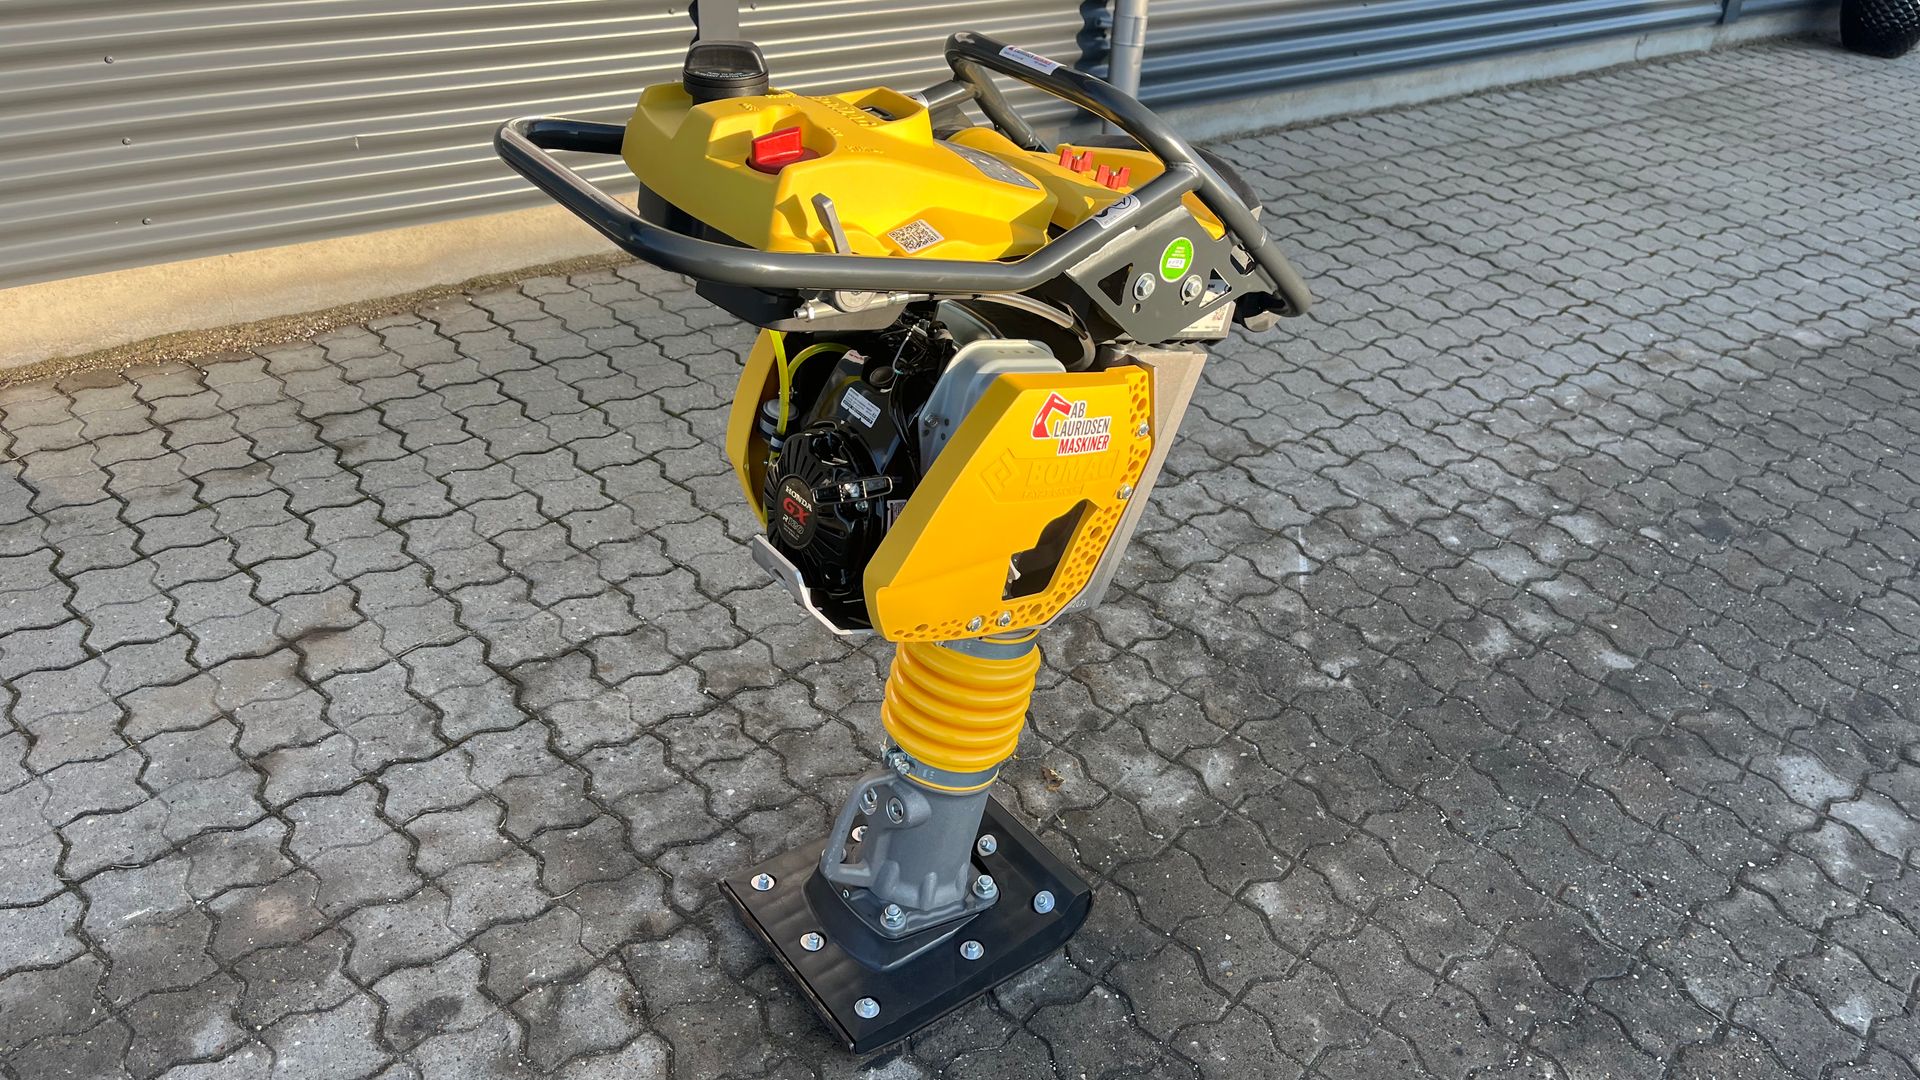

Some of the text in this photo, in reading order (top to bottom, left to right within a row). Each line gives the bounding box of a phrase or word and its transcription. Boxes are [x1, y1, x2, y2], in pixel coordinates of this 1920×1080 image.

[1070, 402, 1086, 418] AB
[1054, 418, 1110, 437] LAURIDSEN
[1058, 435, 1110, 454] MASKINER
[785, 485, 813, 512] HONDA
[783, 497, 810, 526] GX
